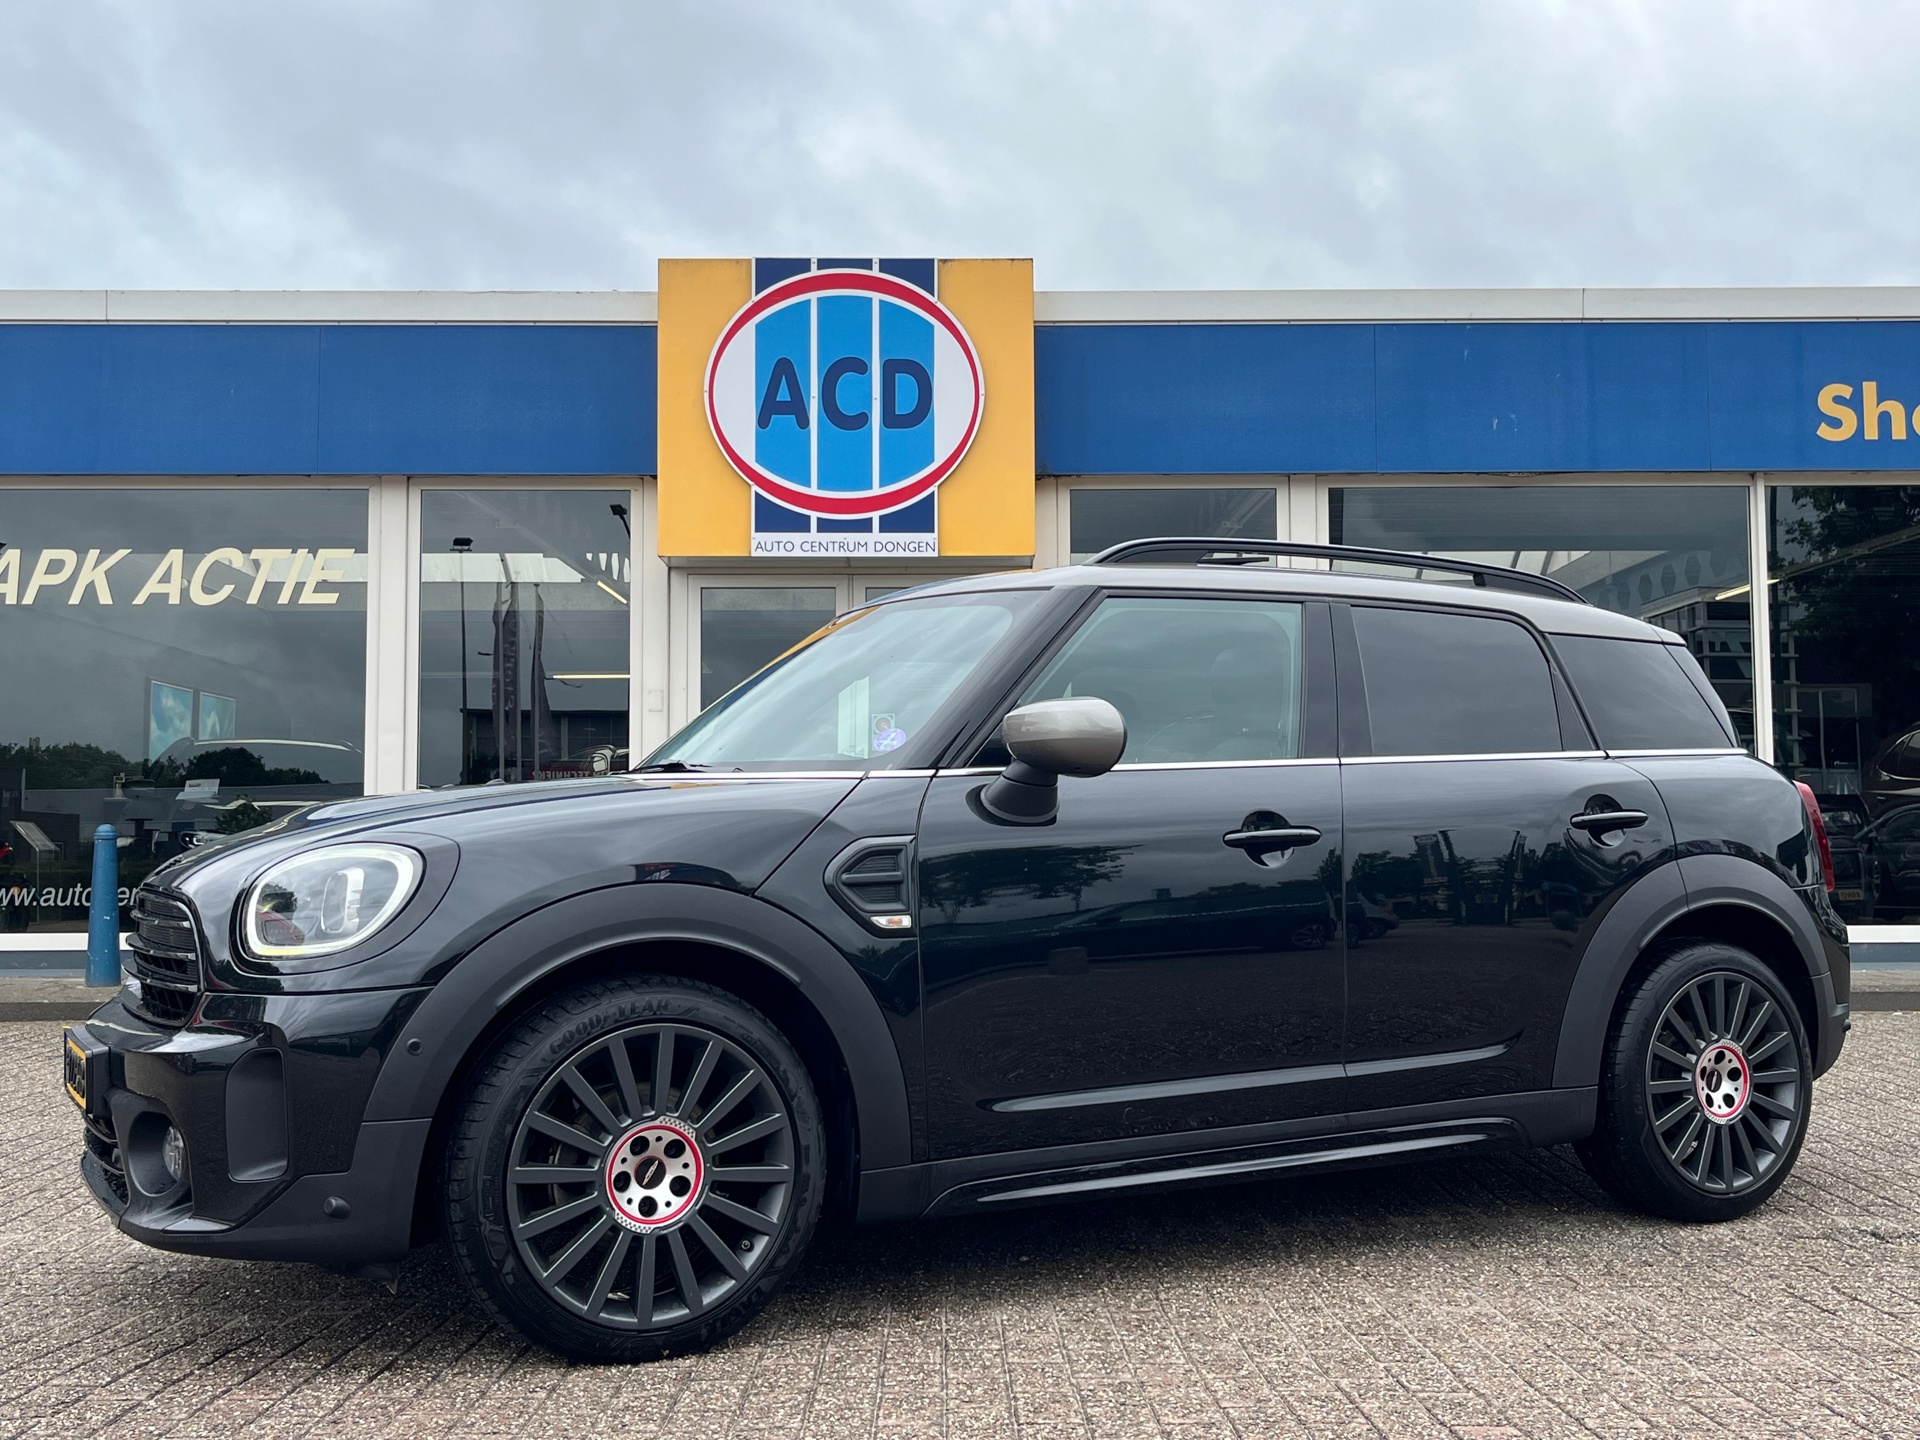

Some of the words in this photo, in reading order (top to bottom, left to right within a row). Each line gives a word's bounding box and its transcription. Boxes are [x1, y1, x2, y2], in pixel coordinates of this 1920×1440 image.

[757, 356, 933, 430] ACD
[1816, 381, 1920, 441] Sh
[132, 547, 355, 606] ACTIE
[755, 541, 795, 553] AUTO
[800, 541, 868, 553] CENTRUM
[874, 541, 936, 553] DONGEN
